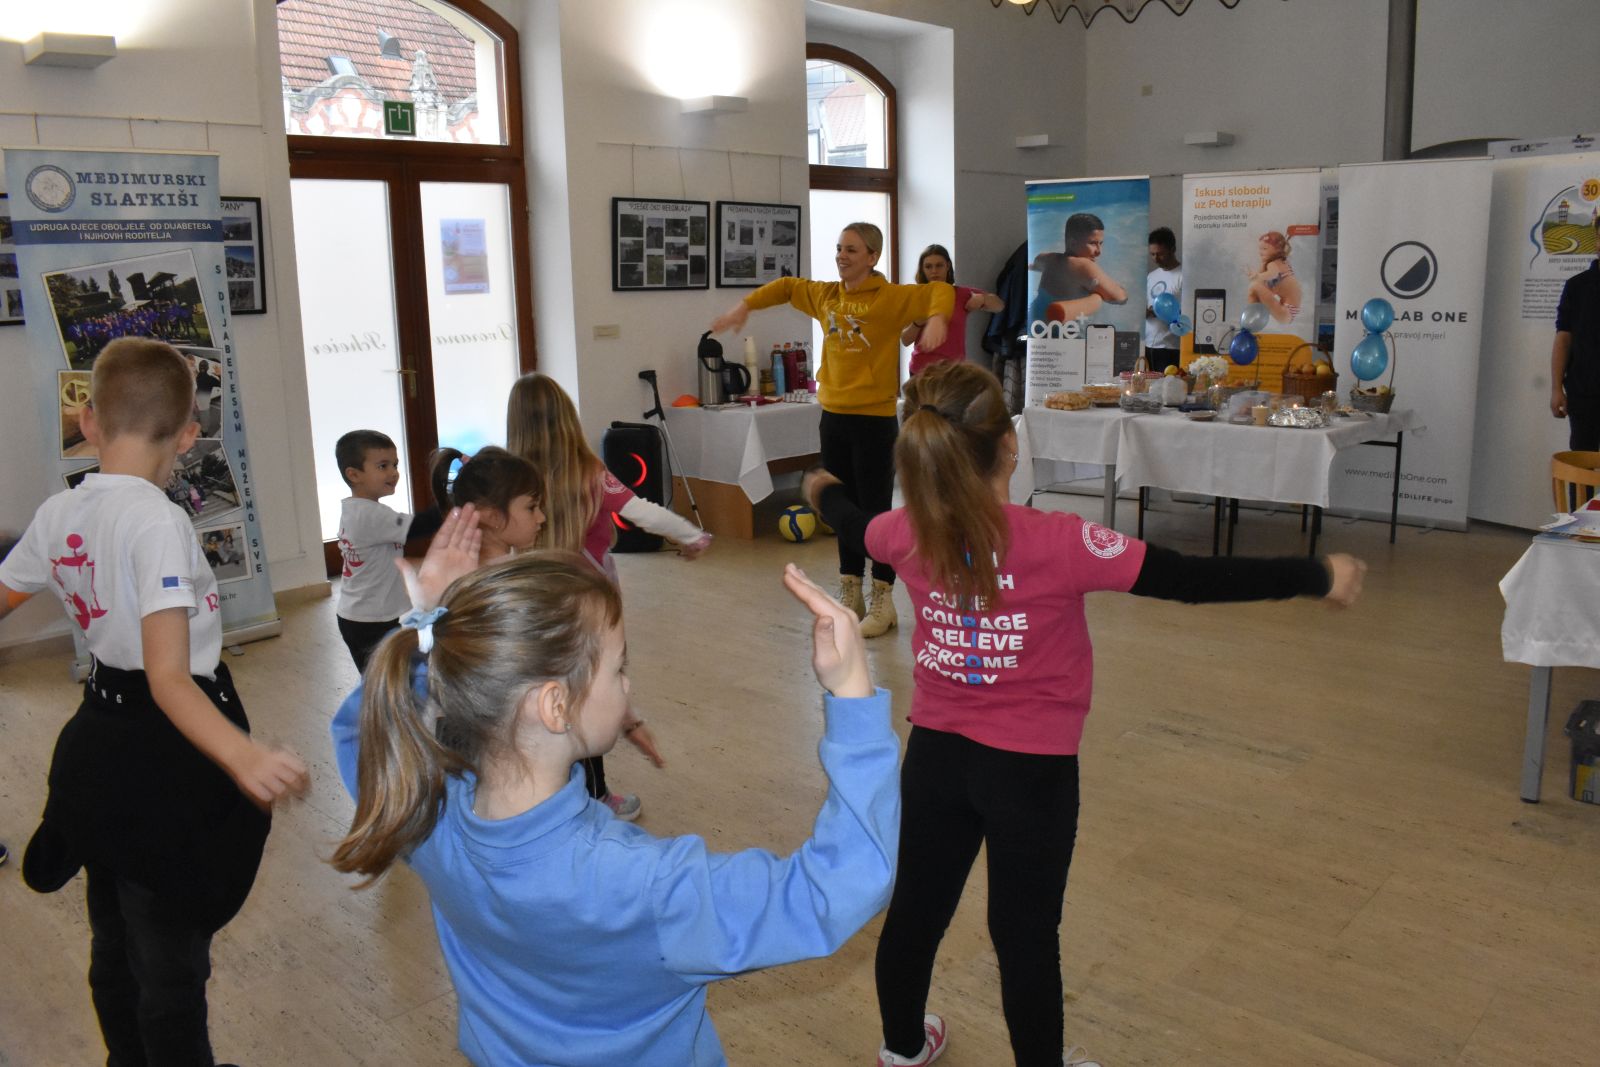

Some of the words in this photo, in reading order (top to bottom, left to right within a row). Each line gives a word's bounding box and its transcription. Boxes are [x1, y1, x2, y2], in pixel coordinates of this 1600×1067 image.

[76, 172, 206, 186] MEĐIMURSKI
[1194, 186, 1225, 197] Iskusi
[1228, 185, 1270, 196] slobodu
[1583, 184, 1598, 197] 30
[91, 189, 199, 206] SLATKIŠI
[1194, 200, 1206, 209] uz
[1208, 198, 1229, 209] Pod
[1231, 197, 1272, 210] terapiju
[1193, 213, 1240, 222] Pojednostavite
[30, 223, 70, 232] UDRUGA
[71, 223, 98, 231] DJECE
[101, 223, 145, 231] OBOLJELE
[164, 222, 212, 230] DIJABETESA
[84, 232, 123, 240] NJIHOVIH
[125, 231, 171, 239] RODITELJA
[1431, 311, 1468, 322] ONE
[215, 265, 221, 274] S
[218, 291, 242, 433] DIJABETESOM
[238, 449, 255, 522] MOŽEMO
[252, 539, 262, 573] SVE
[1344, 468, 1448, 485] www.medibOne.com
[931, 627, 1024, 651] BELIEVE
